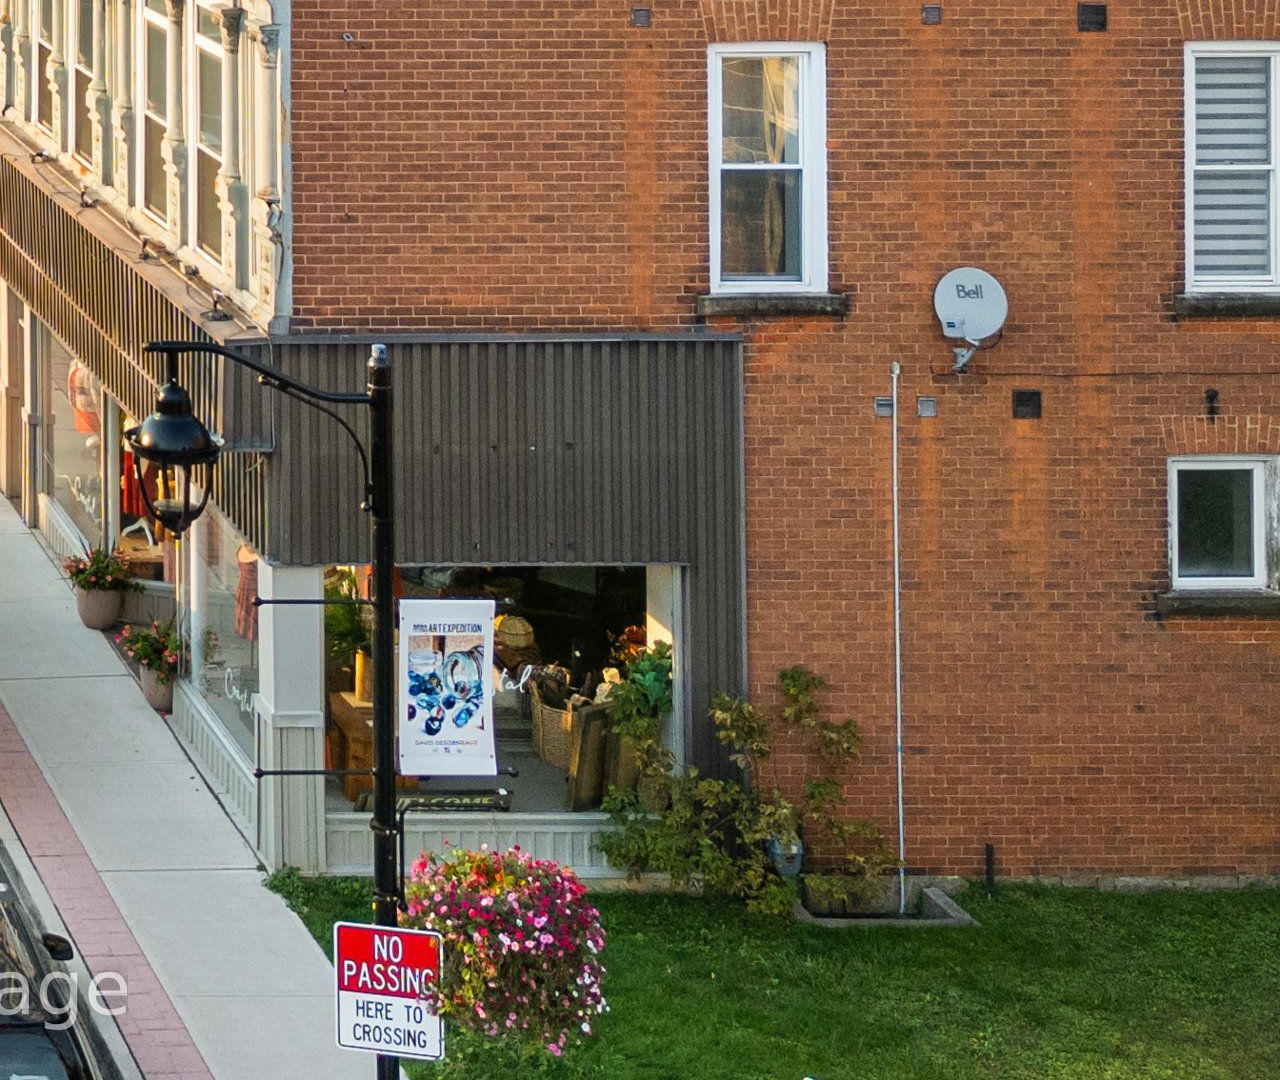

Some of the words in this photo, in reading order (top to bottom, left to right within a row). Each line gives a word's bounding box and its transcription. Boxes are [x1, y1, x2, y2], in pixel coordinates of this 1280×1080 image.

[955, 284, 983, 299] Bell
[374, 934, 403, 963] NO
[343, 960, 434, 995] PASSING
[355, 999, 394, 1021] HERE
[405, 1005, 423, 1024] TO
[353, 1023, 427, 1049] CROSSING
